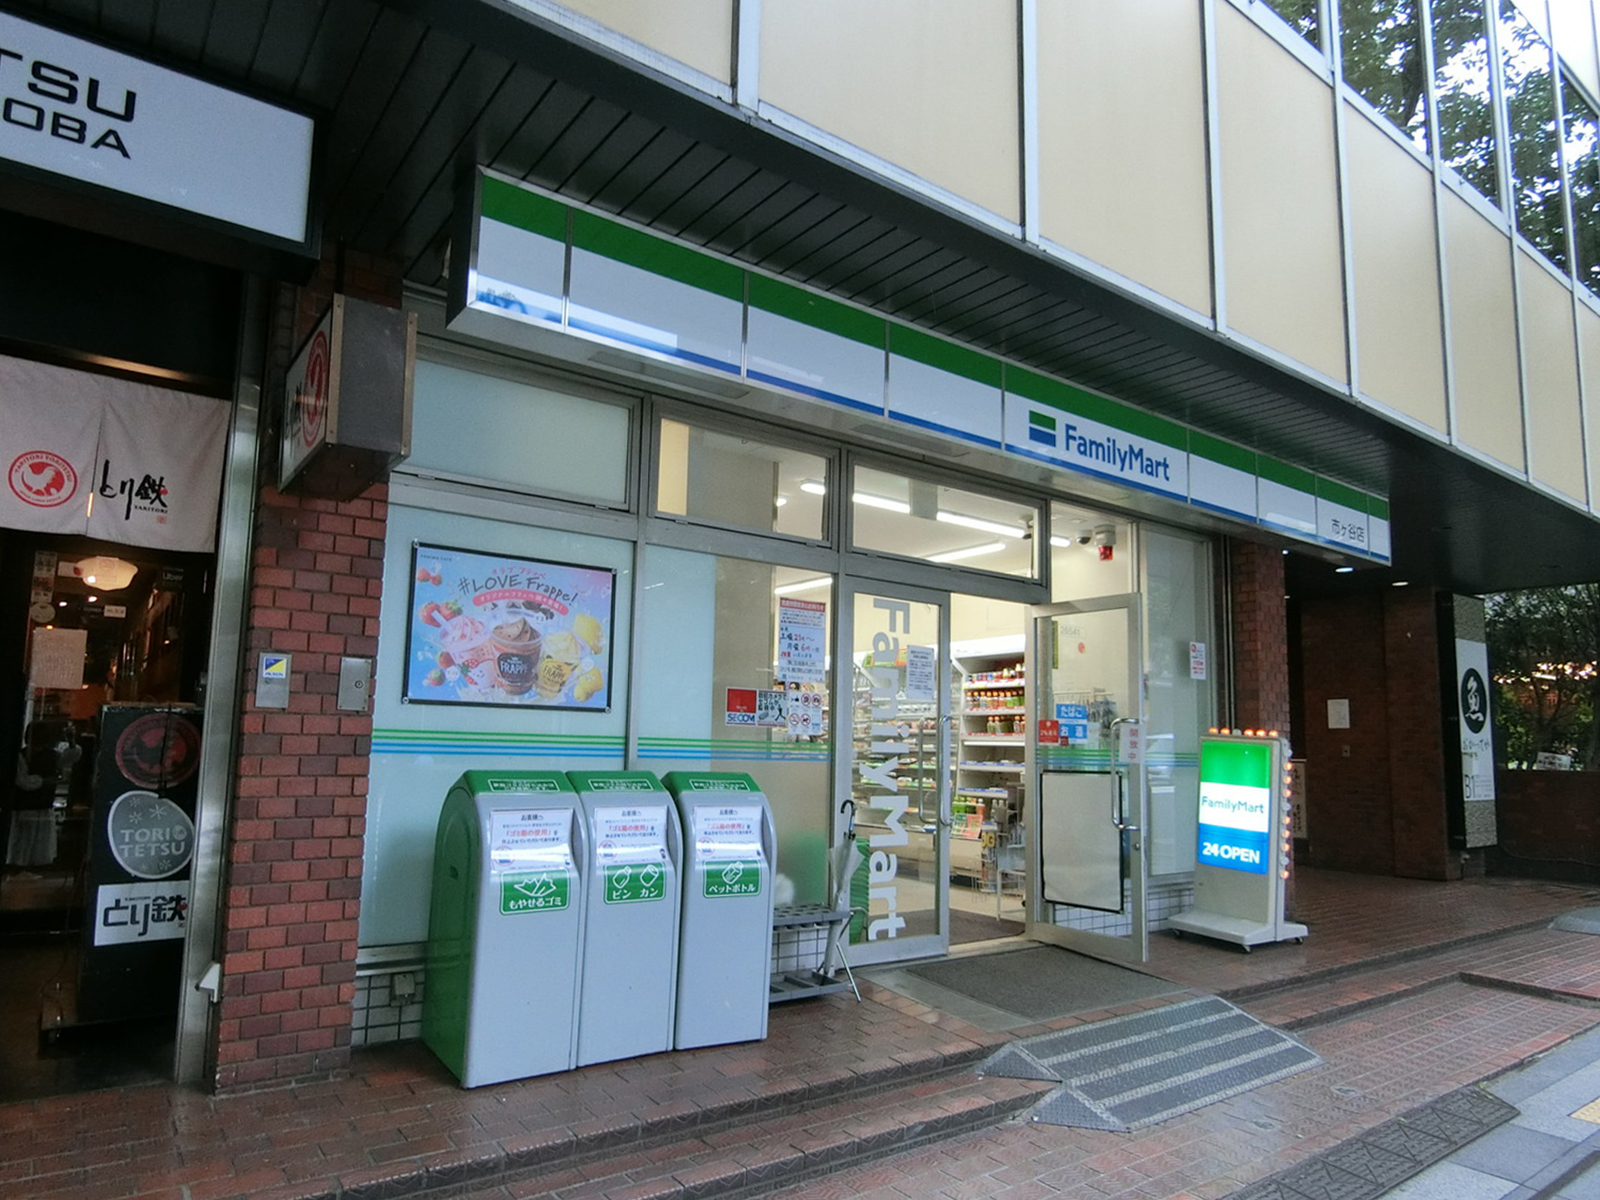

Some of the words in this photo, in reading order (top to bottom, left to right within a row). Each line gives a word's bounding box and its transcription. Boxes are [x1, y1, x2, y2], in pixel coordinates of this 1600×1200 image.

[3, 97, 131, 160] OBA
[1065, 423, 1170, 481] FamilyMart
[99, 458, 169, 520] とり鉄
[458, 574, 522, 596] #LOVE
[526, 576, 579, 606] Frappe!
[727, 713, 756, 723] SECOM
[1060, 706, 1083, 717] たばこ
[860, 597, 910, 942] FamilyMart
[1201, 796, 1265, 814] FamilyMart
[120, 828, 171, 842] TORI
[119, 842, 185, 857] TETSU
[640, 887, 659, 898] カン
[709, 884, 756, 894] ペットボトル
[509, 897, 562, 910] もやせるゴミ
[103, 894, 187, 937] とり鉄
